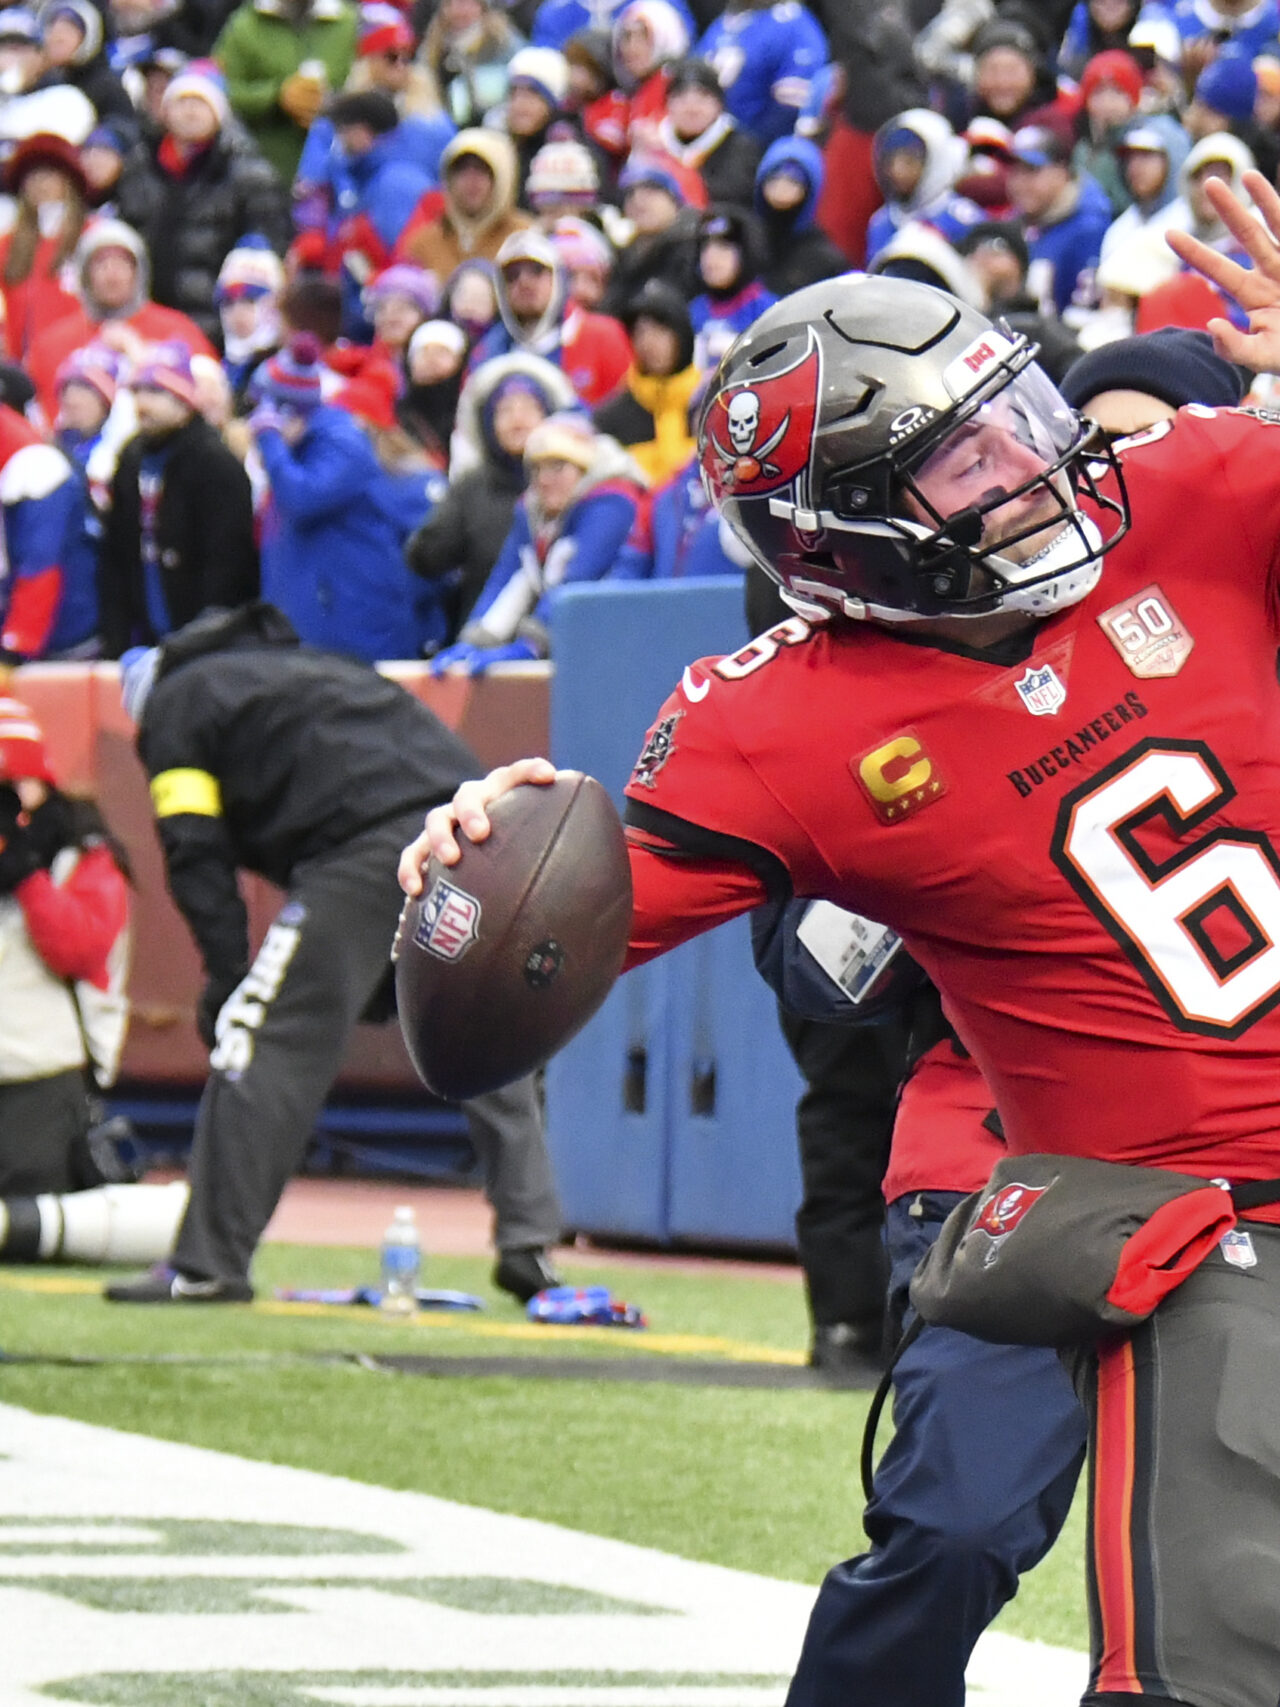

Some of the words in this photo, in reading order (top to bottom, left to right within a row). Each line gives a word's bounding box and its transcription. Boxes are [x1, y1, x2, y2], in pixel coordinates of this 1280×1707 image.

[888, 409, 936, 446] OAKLEY
[711, 615, 814, 682] 6
[1109, 596, 1175, 653] 50
[1028, 685, 1060, 710] NFL
[859, 736, 932, 803] C
[1006, 690, 1149, 798] BUCCANEERS
[431, 900, 473, 954] NFL
